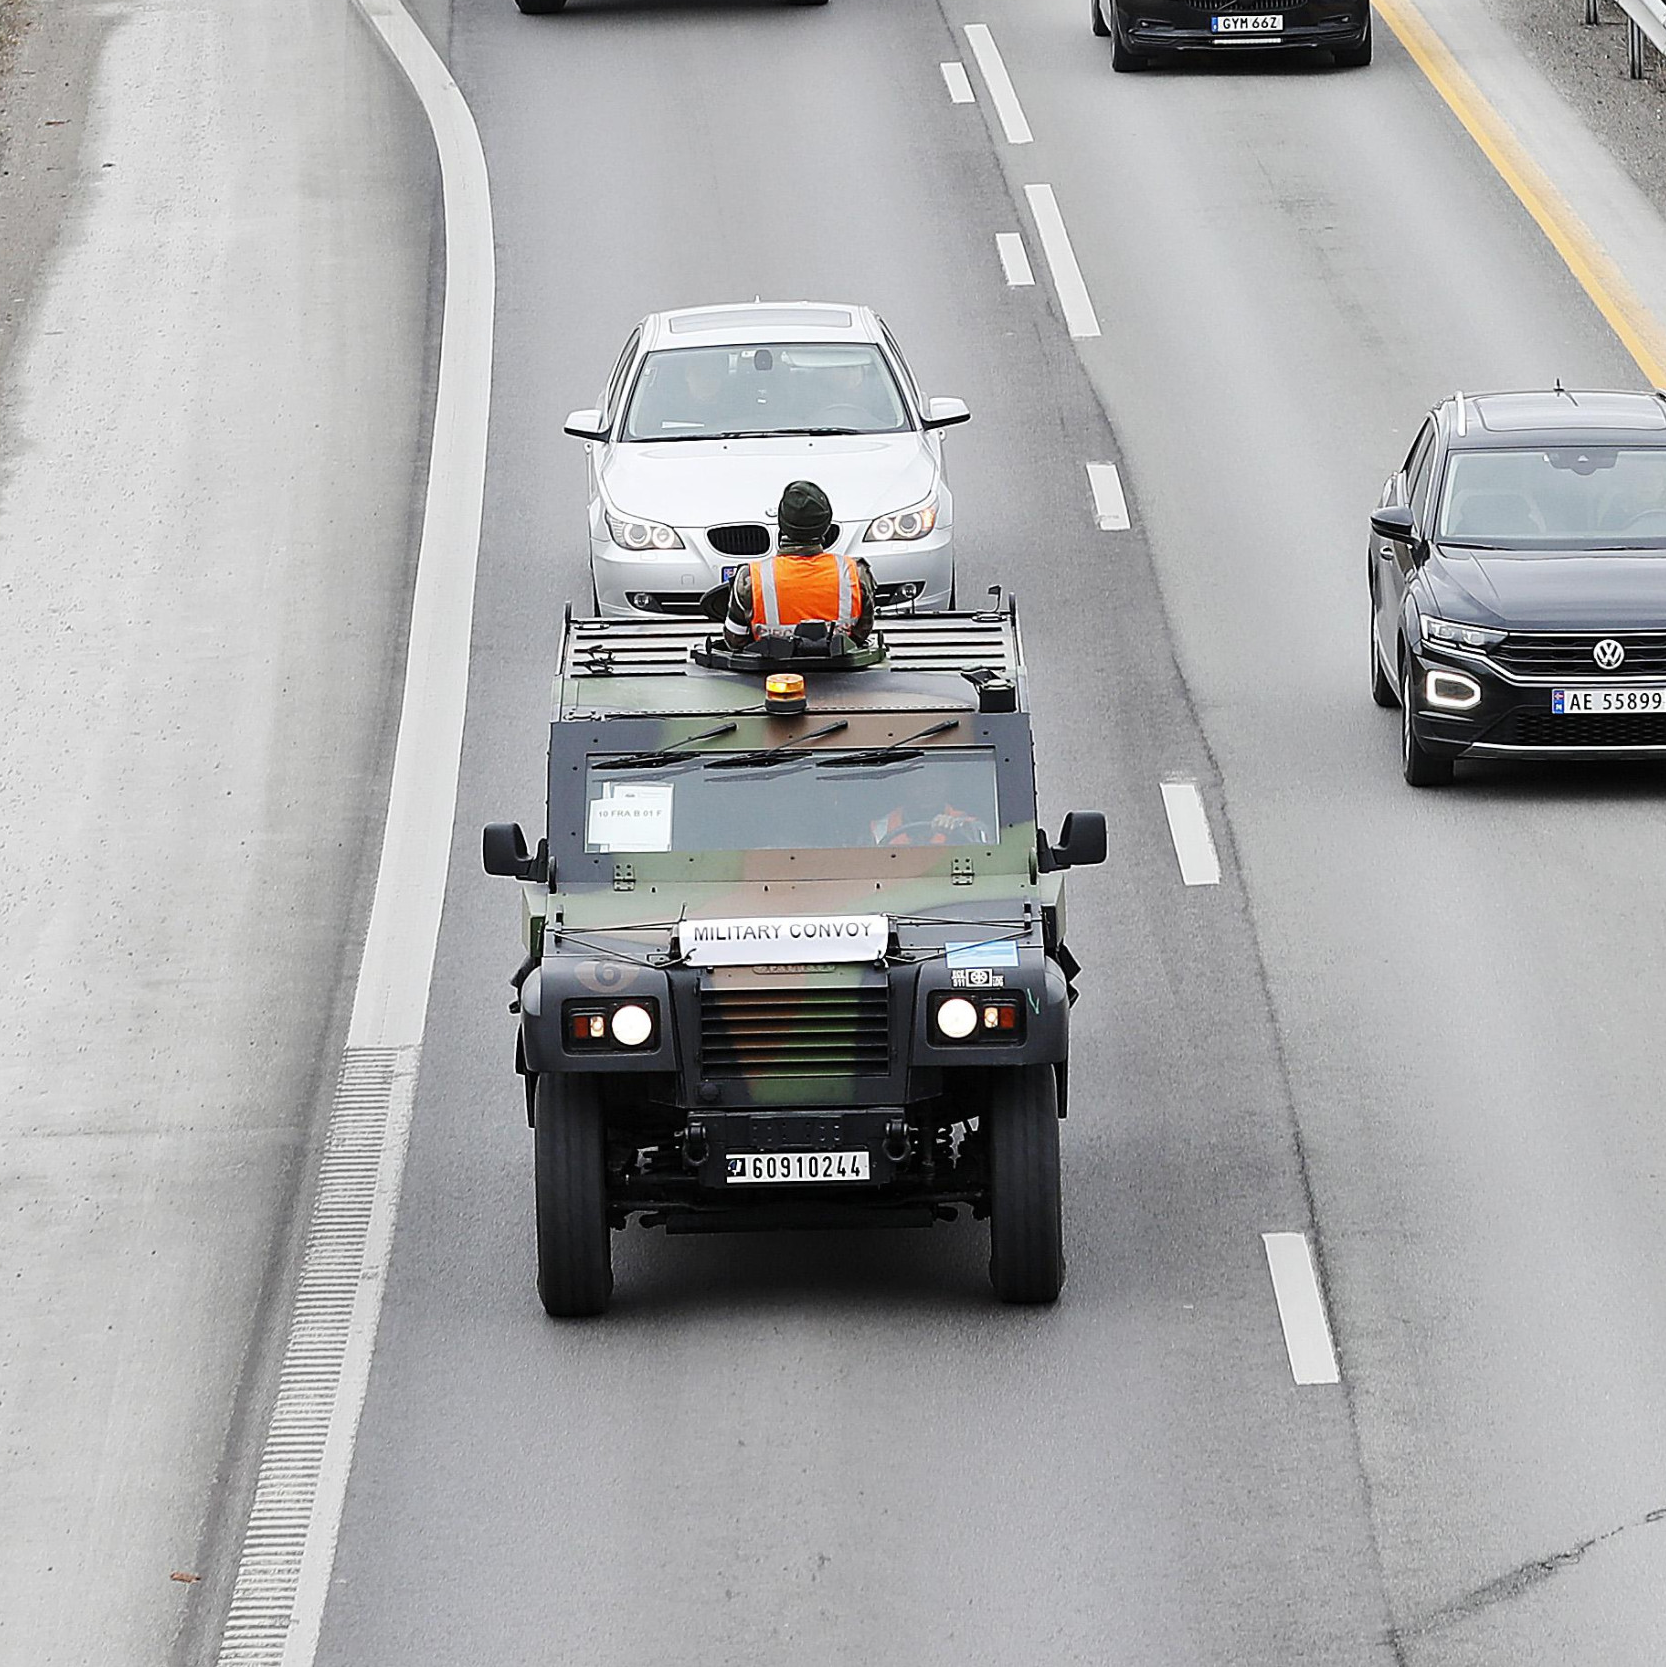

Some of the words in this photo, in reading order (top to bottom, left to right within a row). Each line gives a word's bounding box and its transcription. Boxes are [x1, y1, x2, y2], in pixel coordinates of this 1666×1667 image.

[1222, 17, 1249, 30] GYM
[1252, 16, 1277, 28] 66Z
[1570, 694, 1593, 710] AE
[1603, 693, 1663, 709] 55899
[599, 810, 609, 818] 10
[643, 809, 654, 817] 01
[656, 809, 663, 817] F
[694, 925, 783, 942] MILITARY
[789, 922, 873, 939] CONVOY
[753, 1155, 861, 1179] 60910244
